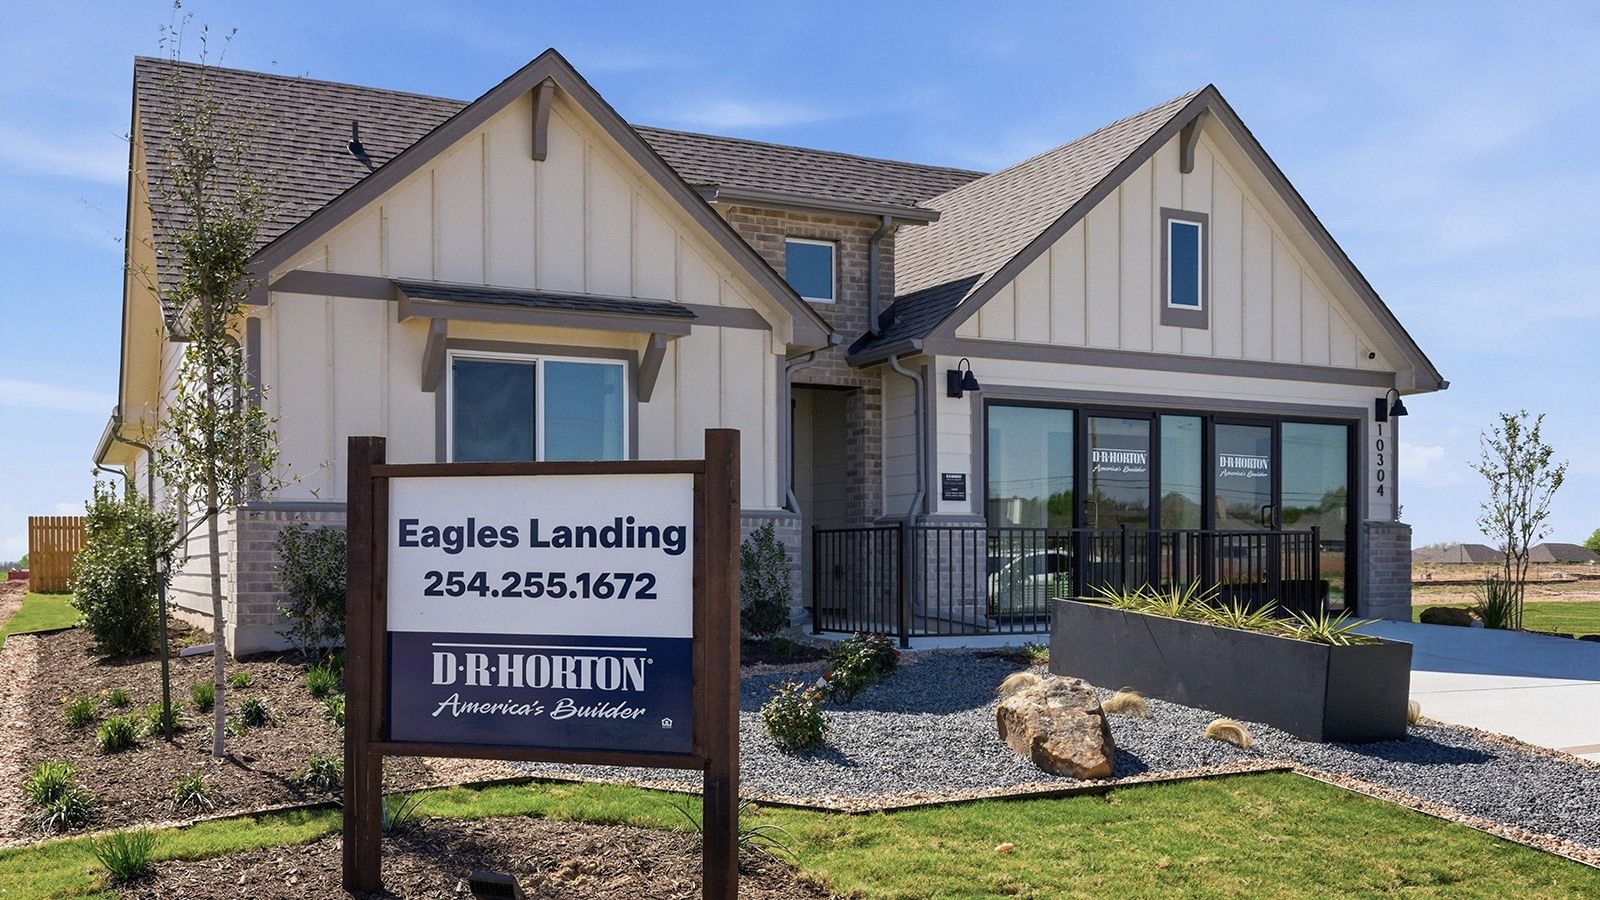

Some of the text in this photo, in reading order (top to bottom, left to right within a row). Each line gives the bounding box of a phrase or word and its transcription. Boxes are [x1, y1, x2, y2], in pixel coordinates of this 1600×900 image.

[1376, 423, 1385, 497] 10304
[398, 515, 687, 556] Eagles Landing
[423, 570, 658, 600] 254.255.1672
[431, 692, 646, 720] America's Builder
